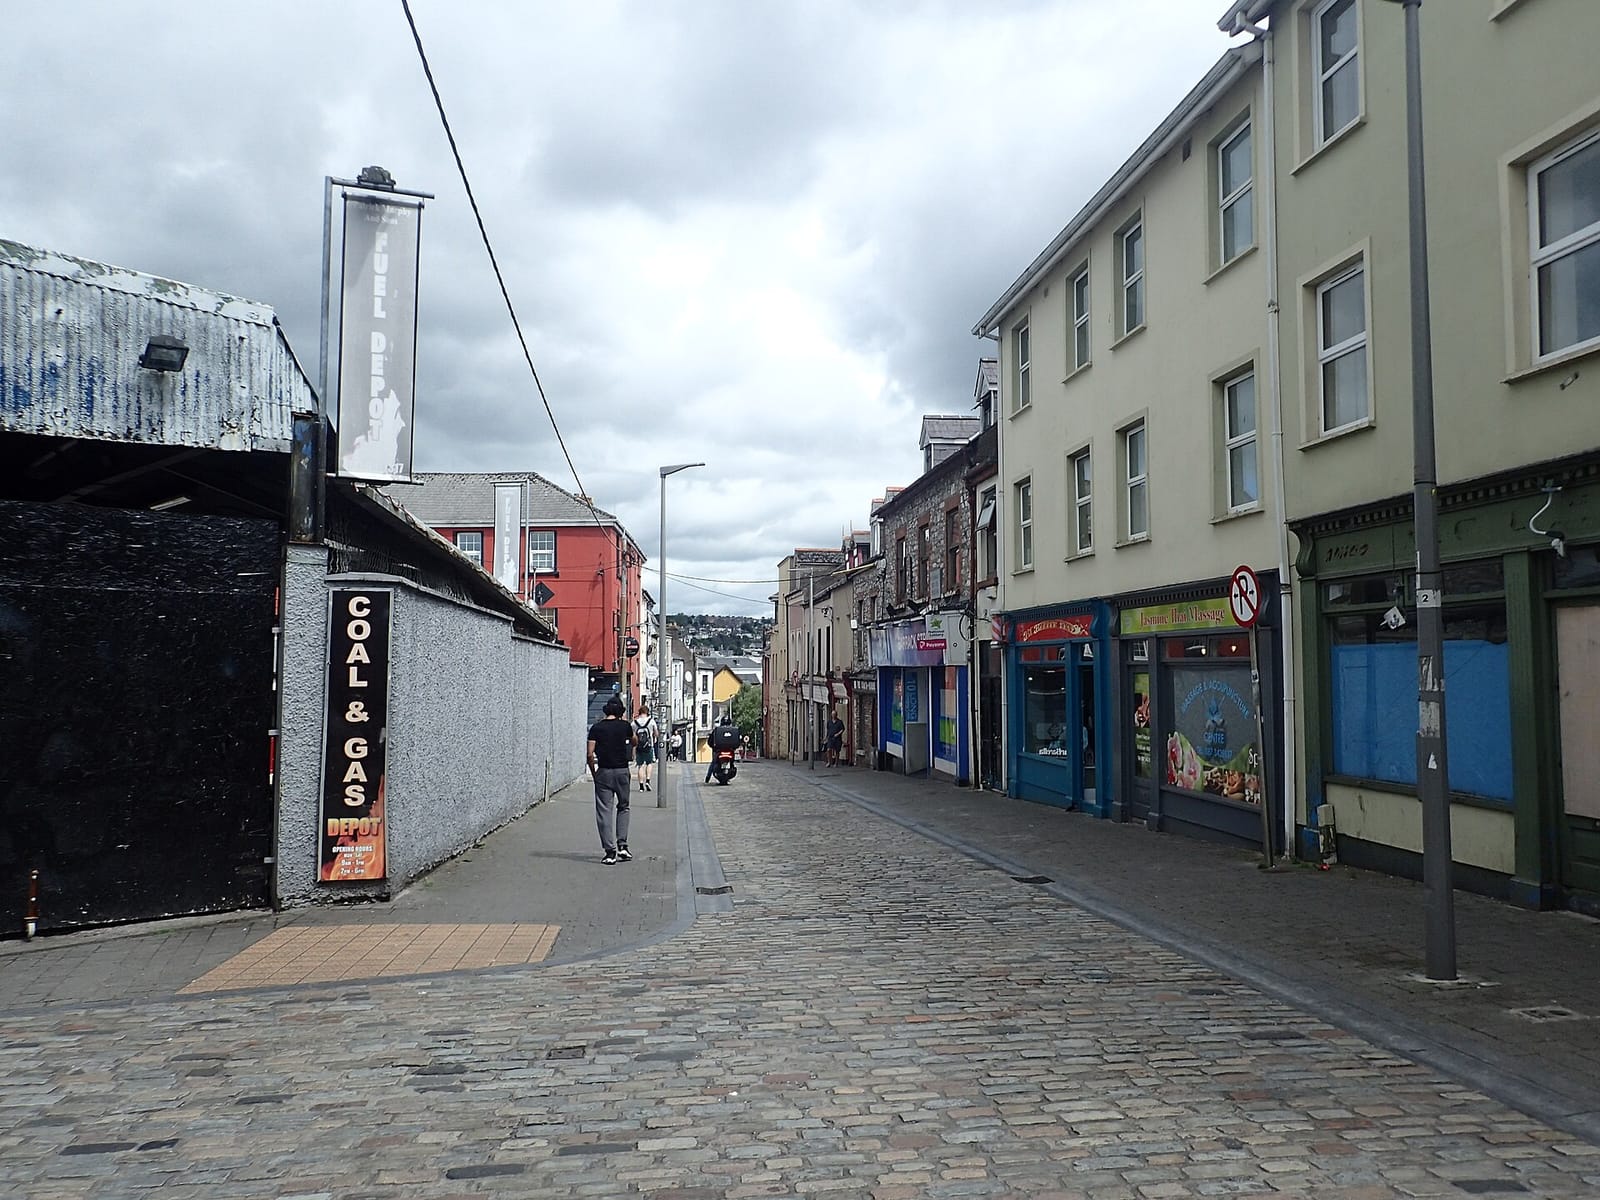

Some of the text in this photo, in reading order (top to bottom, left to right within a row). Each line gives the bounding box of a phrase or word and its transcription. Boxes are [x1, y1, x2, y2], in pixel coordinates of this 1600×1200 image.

[367, 231, 390, 441] FUEL DEPOT
[1422, 594, 1429, 602] 2
[1140, 612, 1169, 628] Jasmine
[1188, 606, 1225, 624] Massage
[343, 596, 372, 807] COAL & GAS
[327, 817, 381, 836] DEPOT
